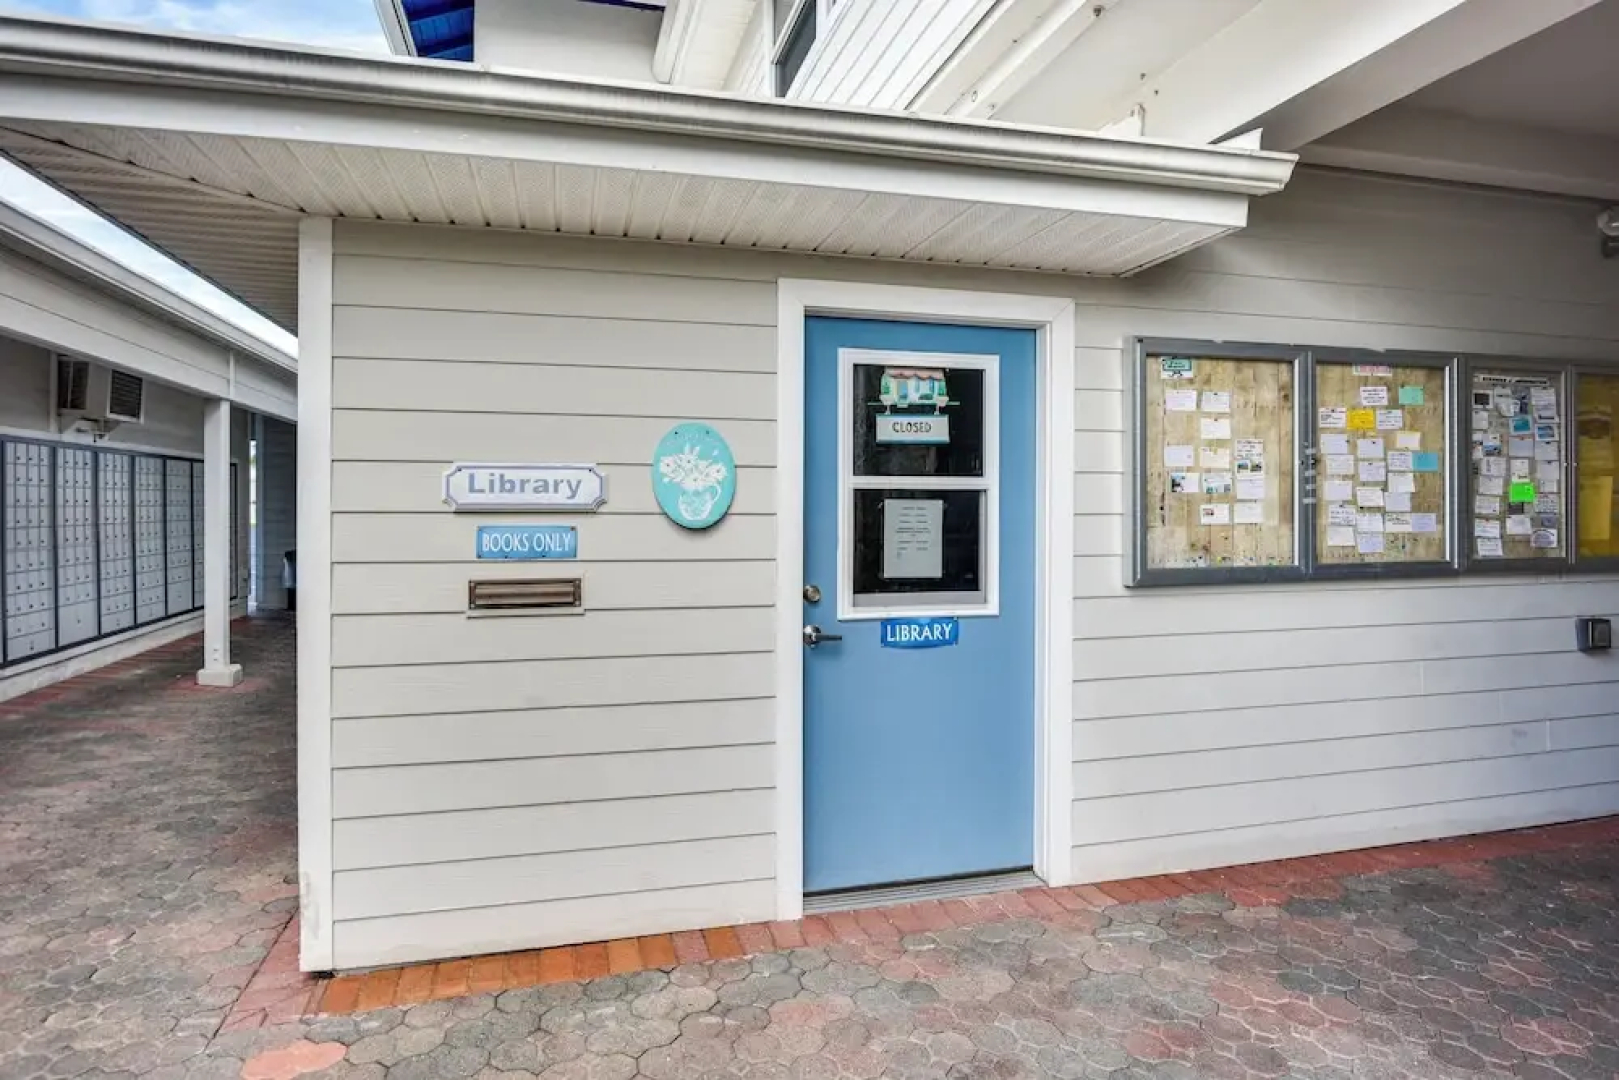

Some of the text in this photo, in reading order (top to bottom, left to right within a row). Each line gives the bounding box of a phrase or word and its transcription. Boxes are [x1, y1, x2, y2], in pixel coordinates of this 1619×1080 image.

[891, 422, 932, 433] CLOSED
[468, 472, 582, 499] Library
[482, 532, 571, 552] BOOKS ONLY
[886, 622, 952, 642] LIBRARY
